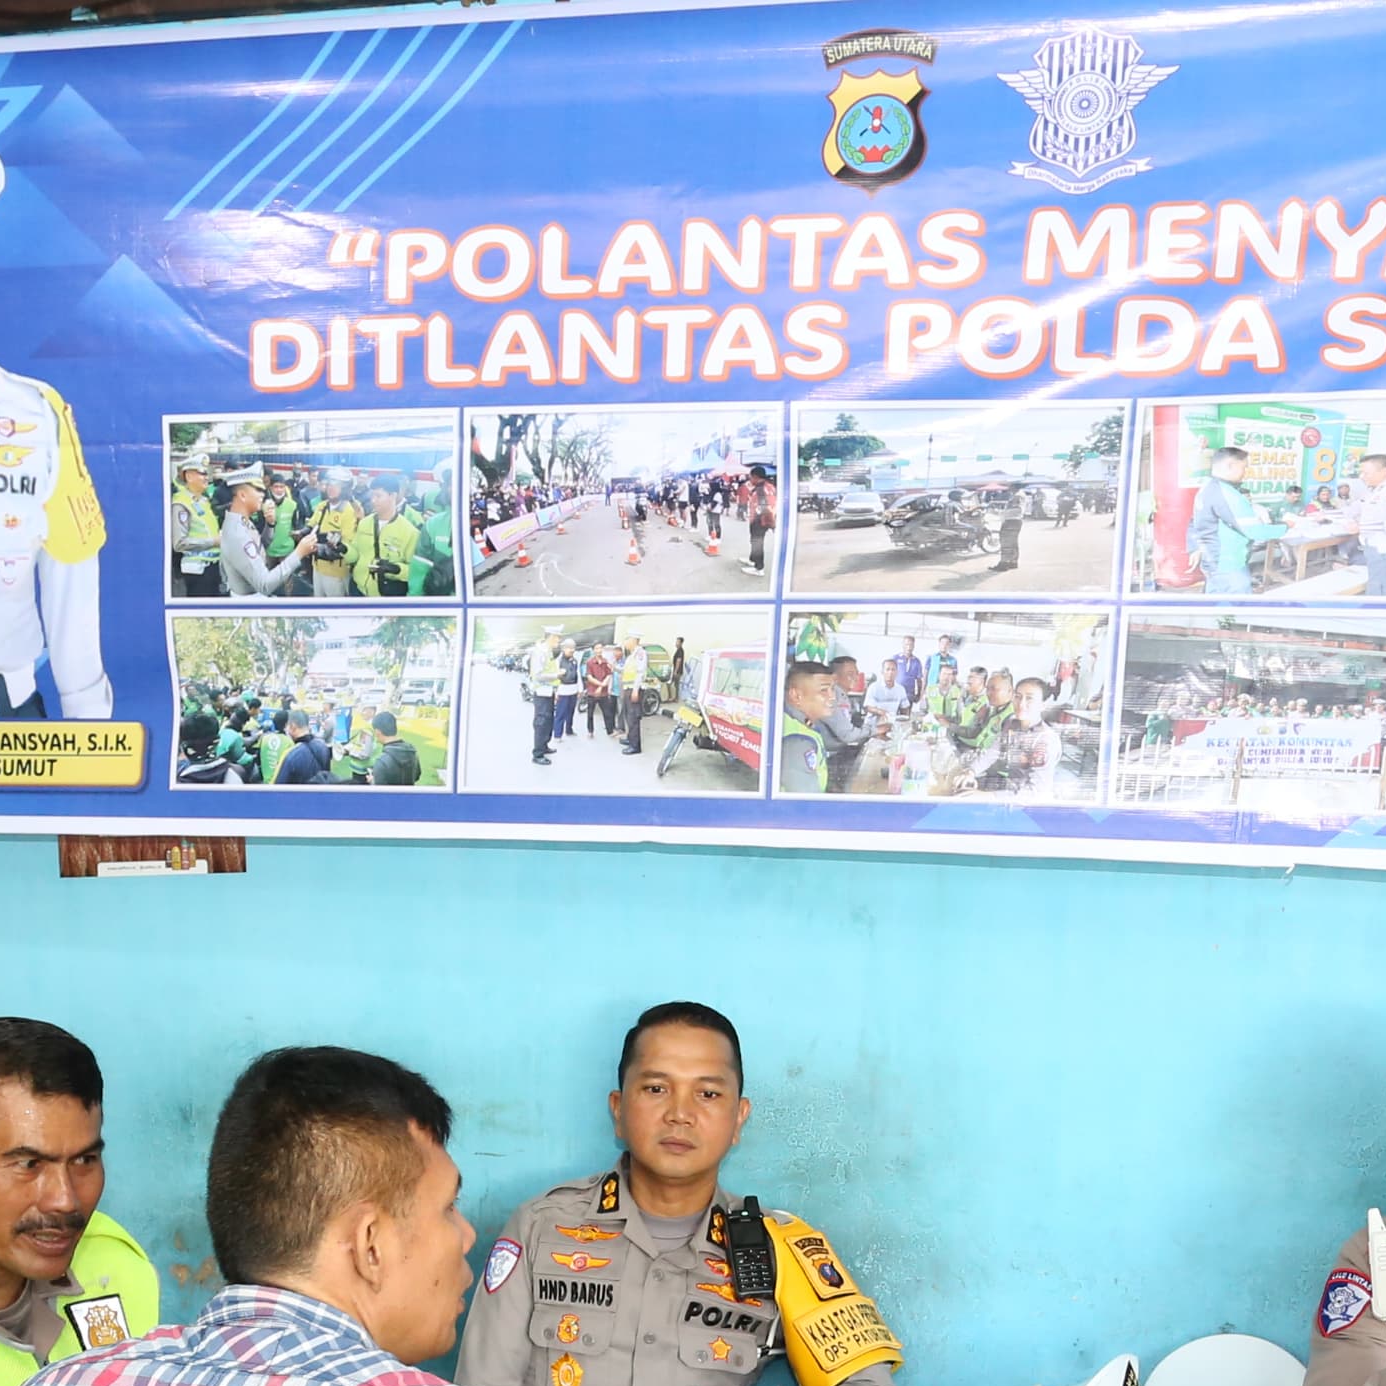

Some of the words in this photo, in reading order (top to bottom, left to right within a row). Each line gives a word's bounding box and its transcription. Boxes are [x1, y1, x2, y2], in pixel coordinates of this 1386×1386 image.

[826, 35, 891, 64] SUMATERA
[892, 35, 934, 60] UTARA
[249, 298, 851, 394] DITLANTAS
[885, 292, 1285, 382] POLDA
[1248, 451, 1297, 466] EMAT
[1313, 448, 1337, 483] 8
[87, 733, 132, 752] S.I.K.
[538, 1279, 566, 1302] HND
[571, 1281, 614, 1307] BARUS
[683, 1301, 763, 1333] POLRI
[824, 1341, 849, 1363] OPS
